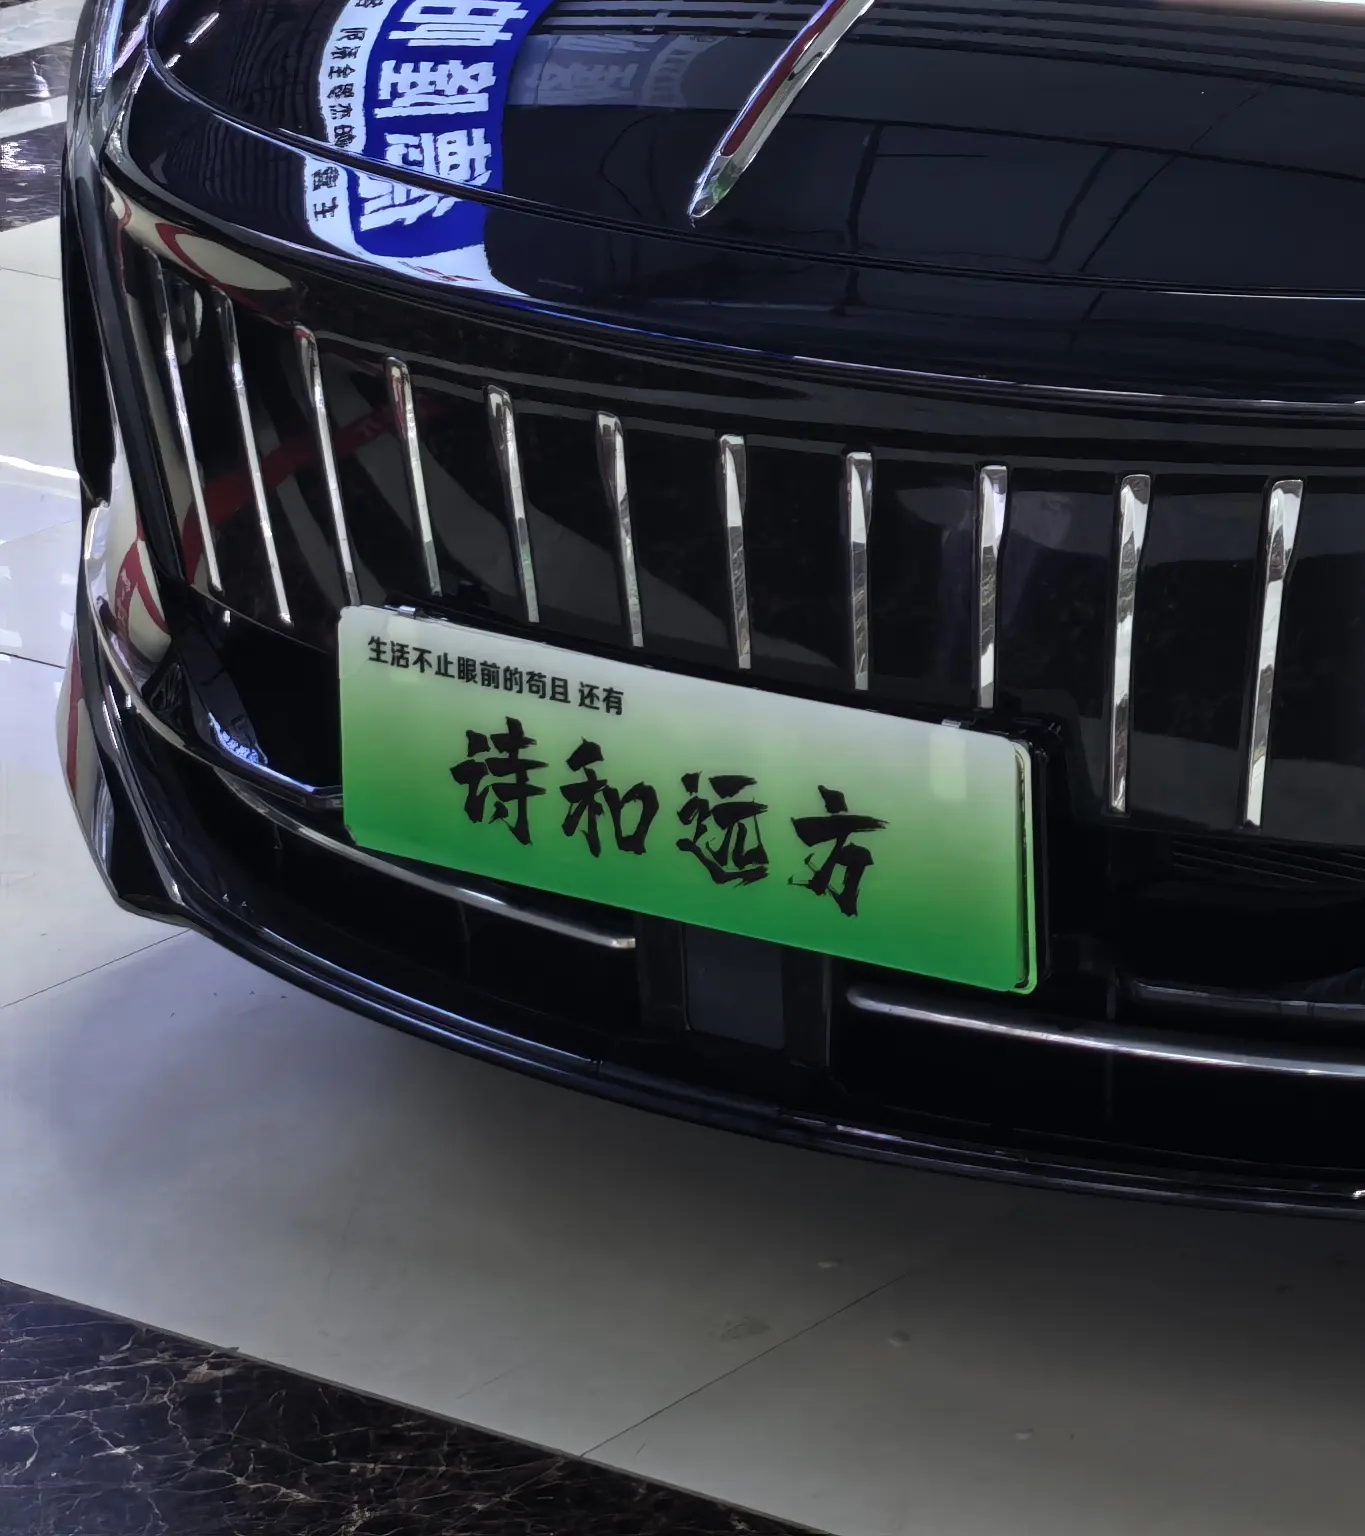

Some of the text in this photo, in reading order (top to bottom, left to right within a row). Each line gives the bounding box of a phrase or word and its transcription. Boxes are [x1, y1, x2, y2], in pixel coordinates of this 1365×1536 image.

[367, 635, 625, 716] 生活不止眼前的苟且 还有
[450, 716, 889, 918] 诗和远方
